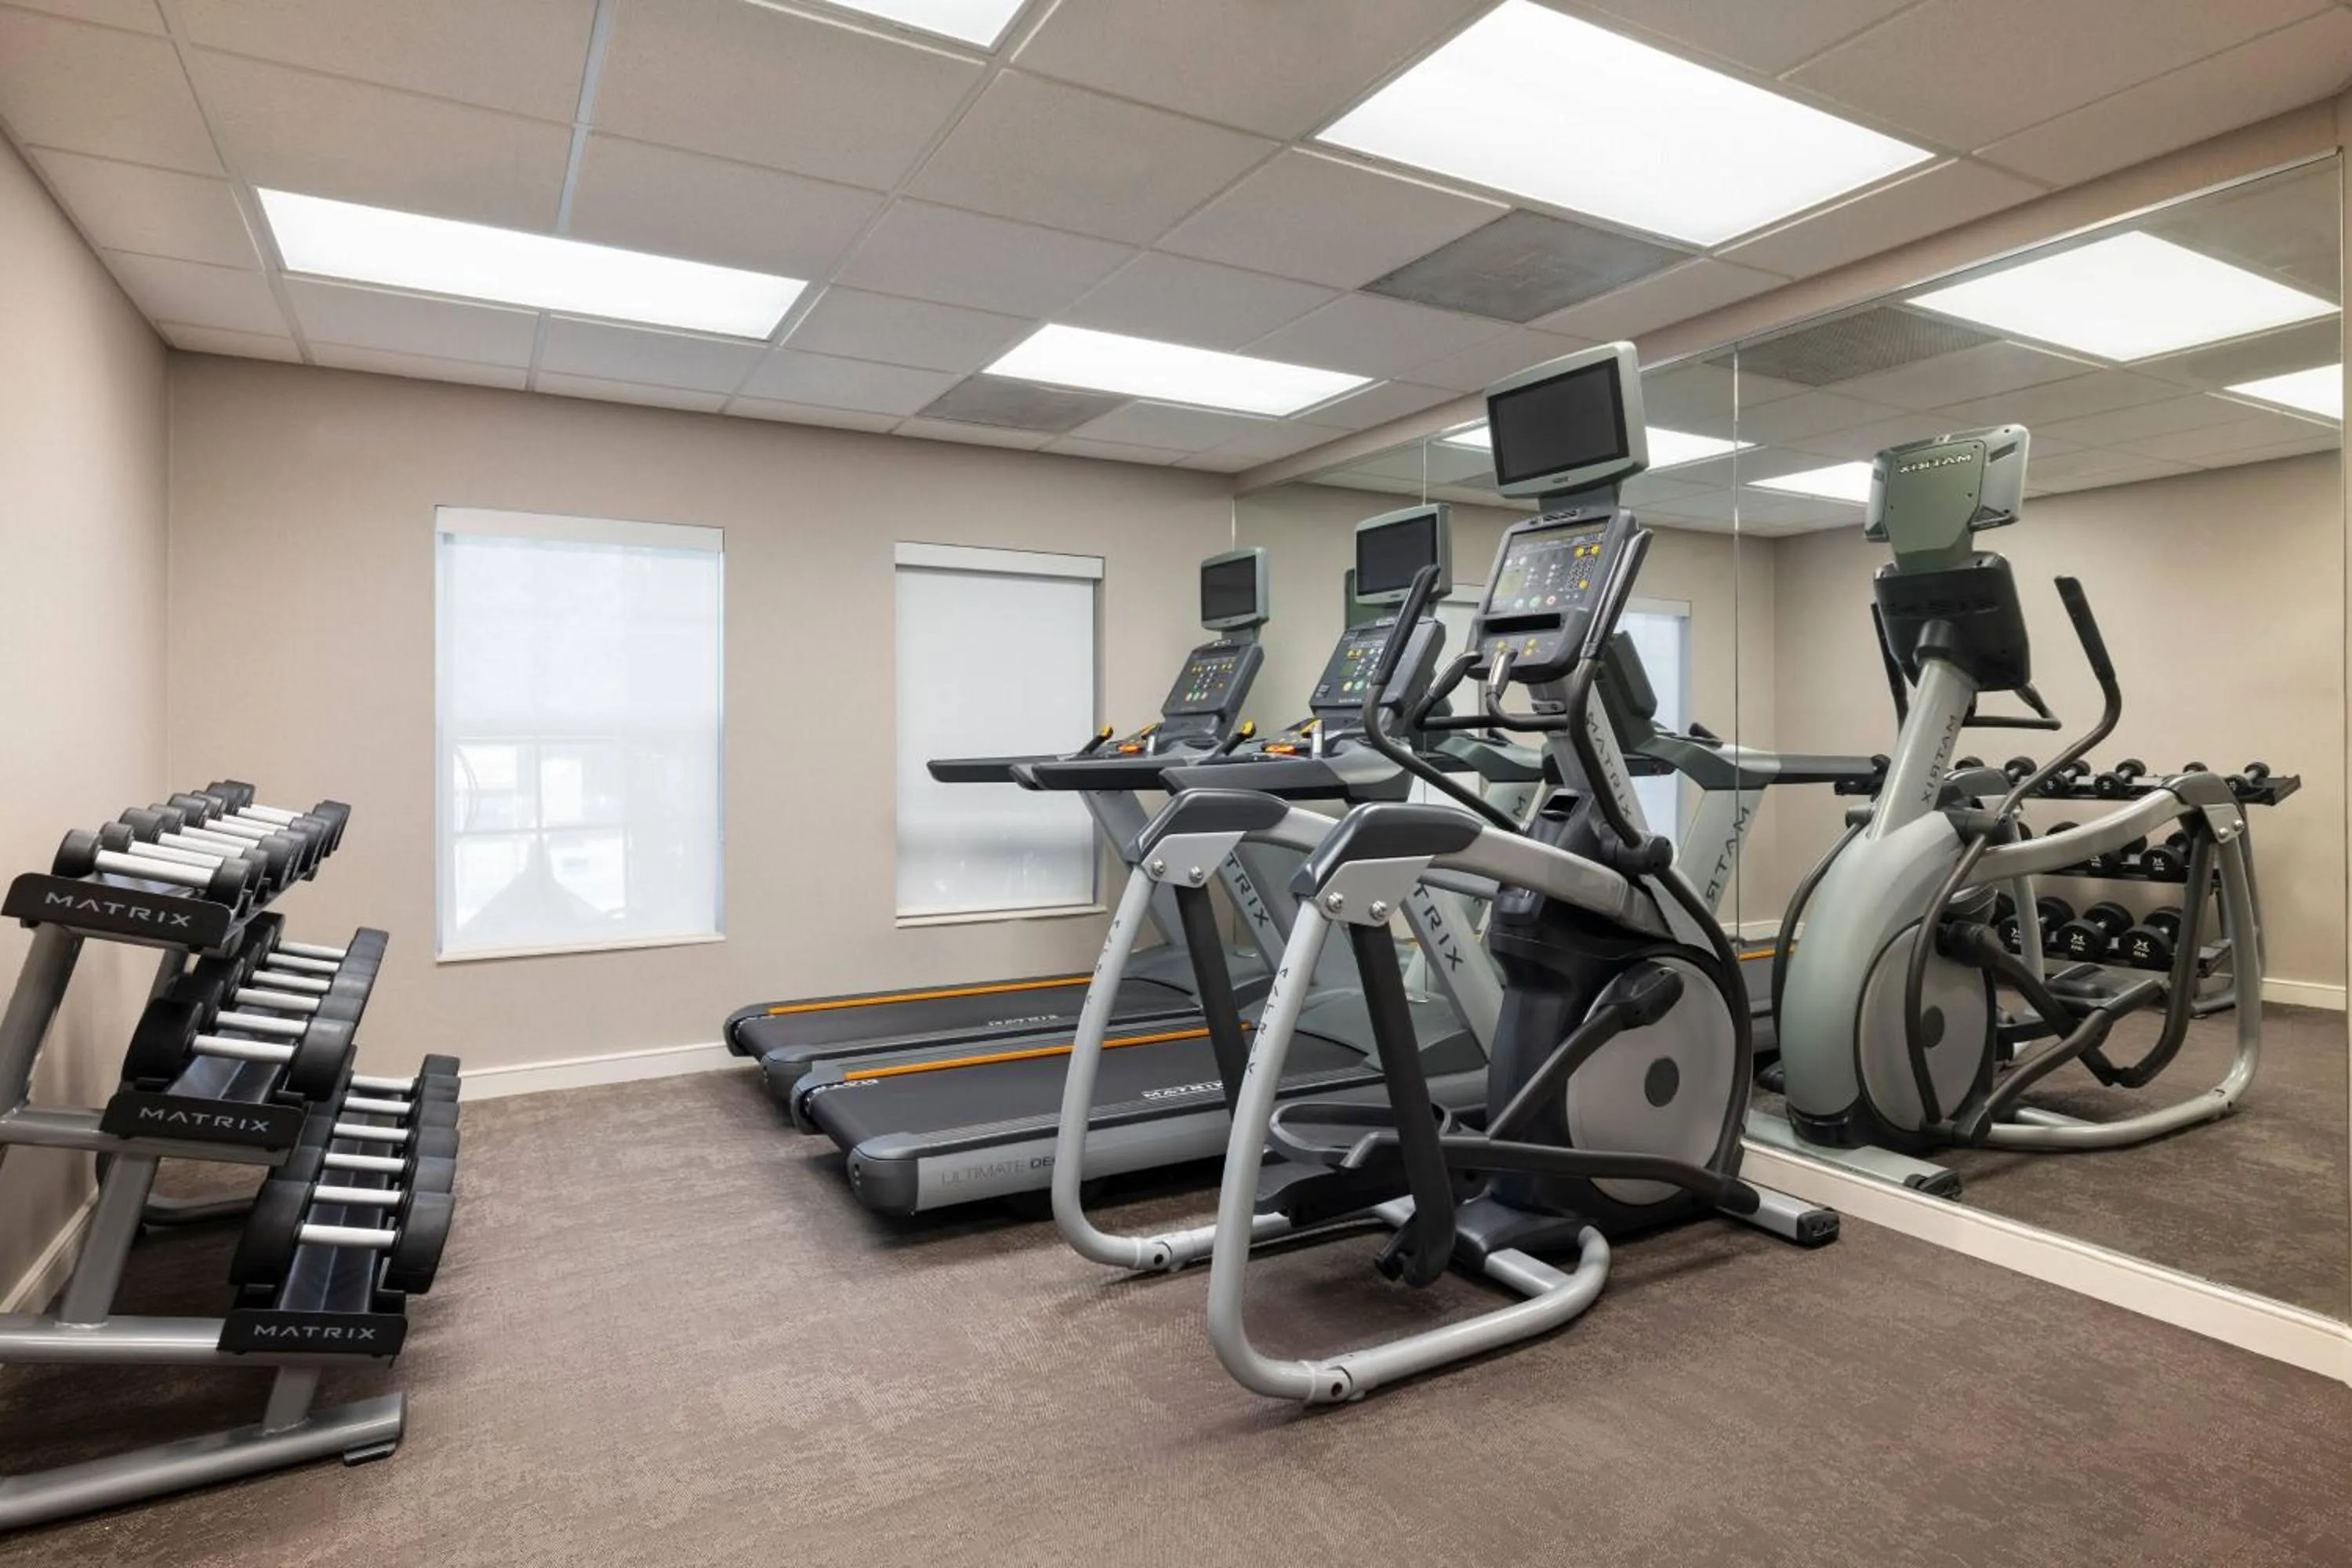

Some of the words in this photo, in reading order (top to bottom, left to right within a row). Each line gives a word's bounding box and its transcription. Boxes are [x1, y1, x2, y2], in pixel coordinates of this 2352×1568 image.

[1585, 712, 1631, 818] MATRIX
[1226, 851, 1269, 928] TRIX
[45, 891, 192, 927] MATRIX
[1414, 883, 1464, 971] TRIX
[139, 1107, 270, 1132] MATRIX
[942, 1160, 1025, 1185] ULTIMATE
[1030, 1156, 1055, 1169] DE
[253, 1324, 376, 1340] MATRIX
